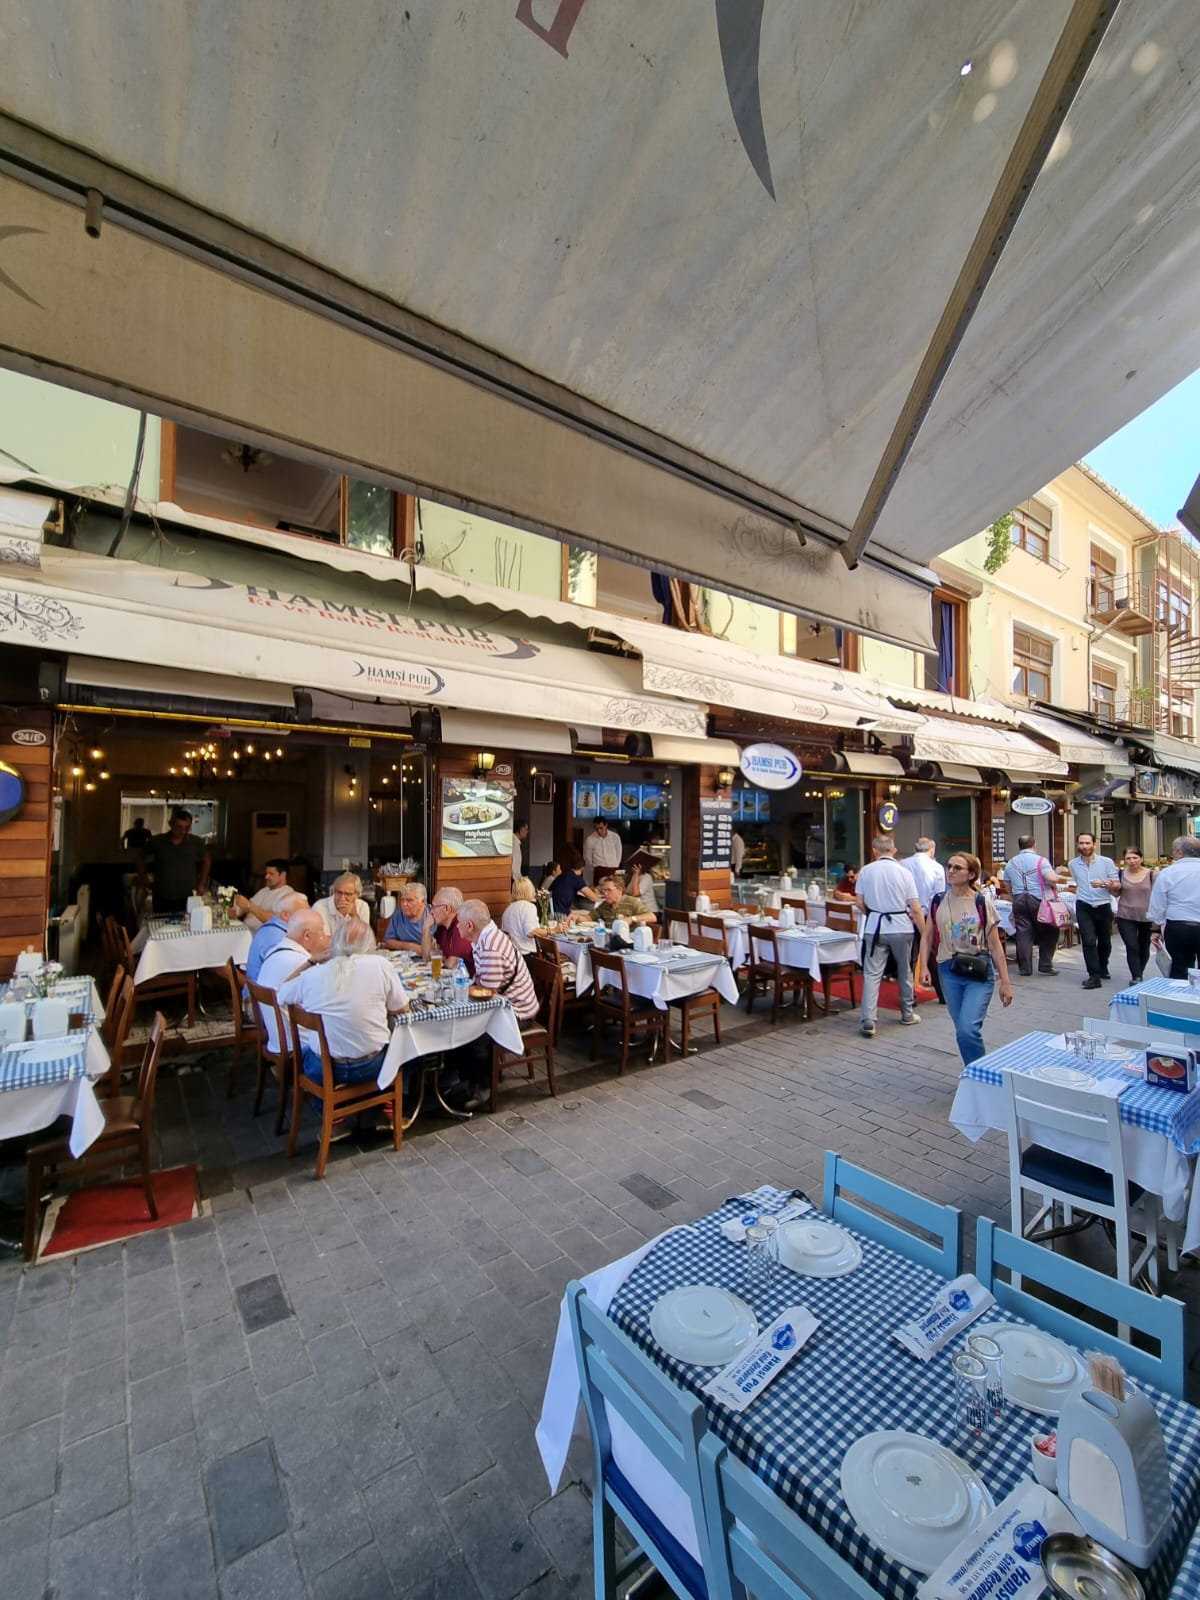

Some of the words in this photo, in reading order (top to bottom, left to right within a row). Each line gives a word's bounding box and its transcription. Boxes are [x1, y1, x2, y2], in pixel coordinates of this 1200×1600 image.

[408, 672, 431, 685] PUB
[741, 1377, 760, 1393] Pub
[996, 1552, 1017, 1576] Balık
